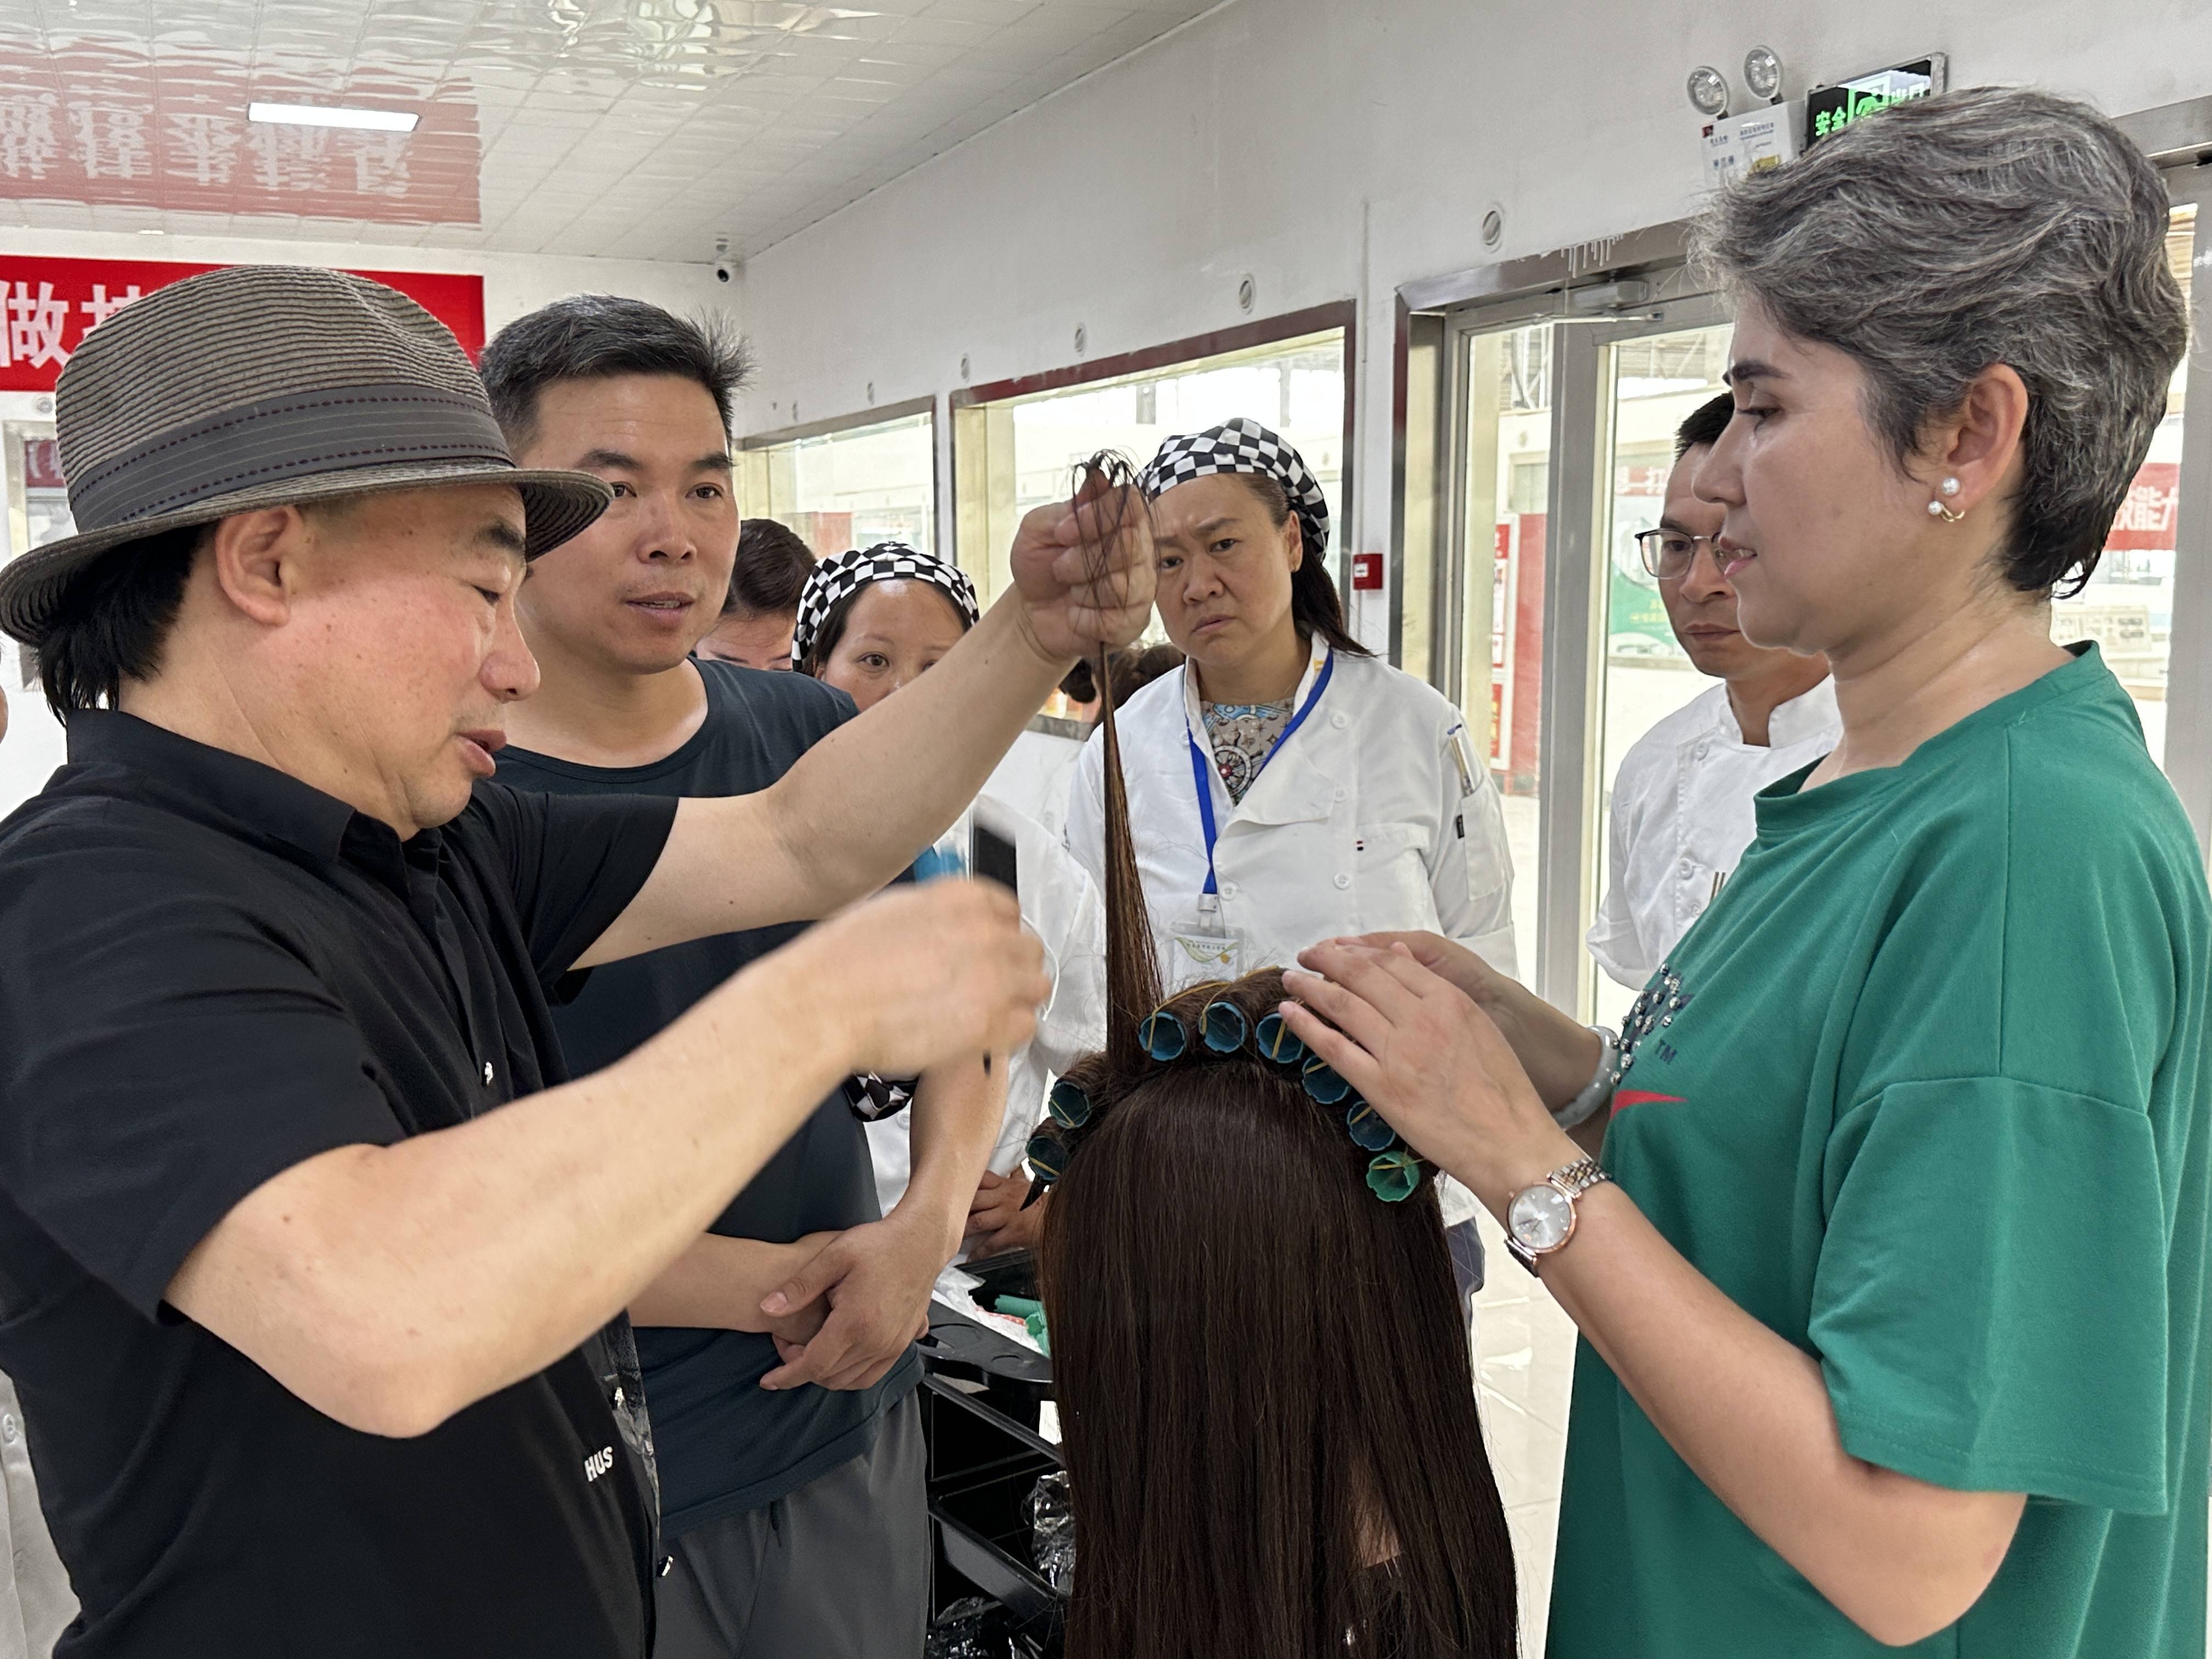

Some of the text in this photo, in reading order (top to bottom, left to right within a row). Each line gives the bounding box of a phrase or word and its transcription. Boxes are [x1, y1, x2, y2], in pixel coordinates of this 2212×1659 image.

[1815, 106, 1846, 137] 安全
[1655, 1039, 1677, 1065] TM
[584, 1446, 613, 1482] HUS
